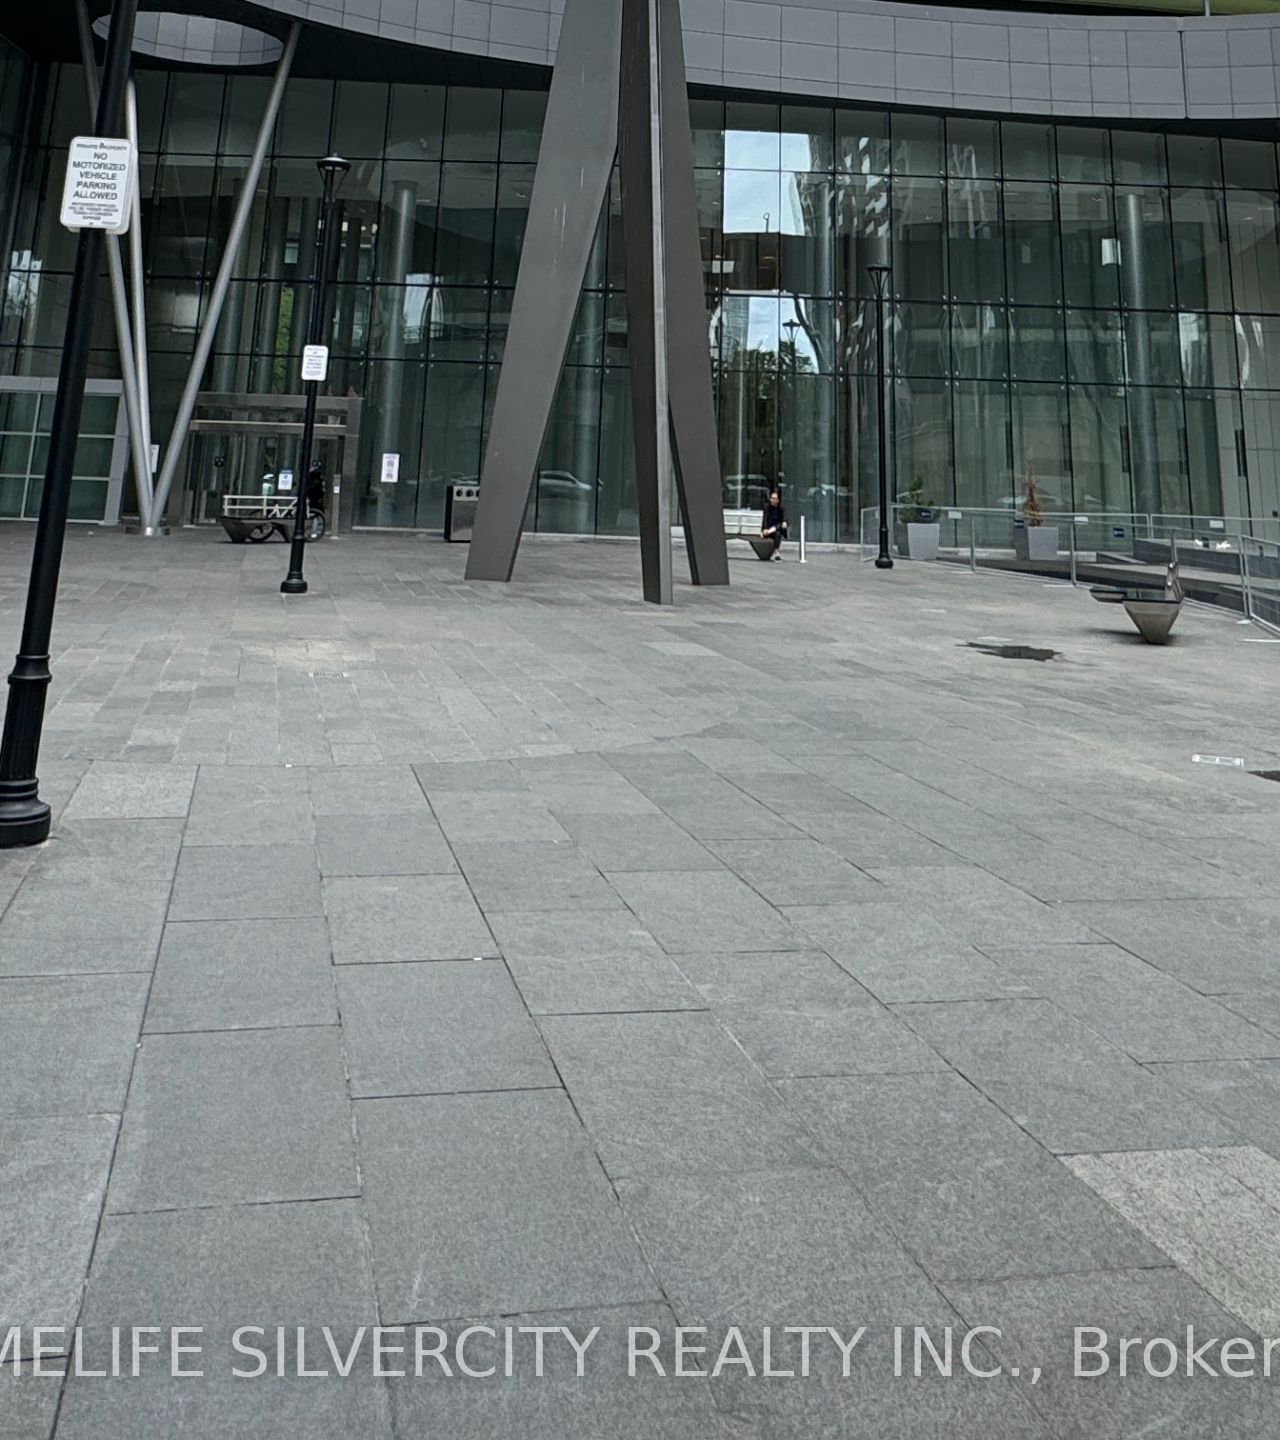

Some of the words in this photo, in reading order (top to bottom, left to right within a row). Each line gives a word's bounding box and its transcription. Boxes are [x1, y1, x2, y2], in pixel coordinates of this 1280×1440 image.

[93, 152, 108, 160] NO
[72, 161, 126, 171] MOTORIZED
[79, 171, 118, 180] VEHICLE
[76, 181, 117, 190] PARKING
[73, 190, 118, 200] ALLOWED
